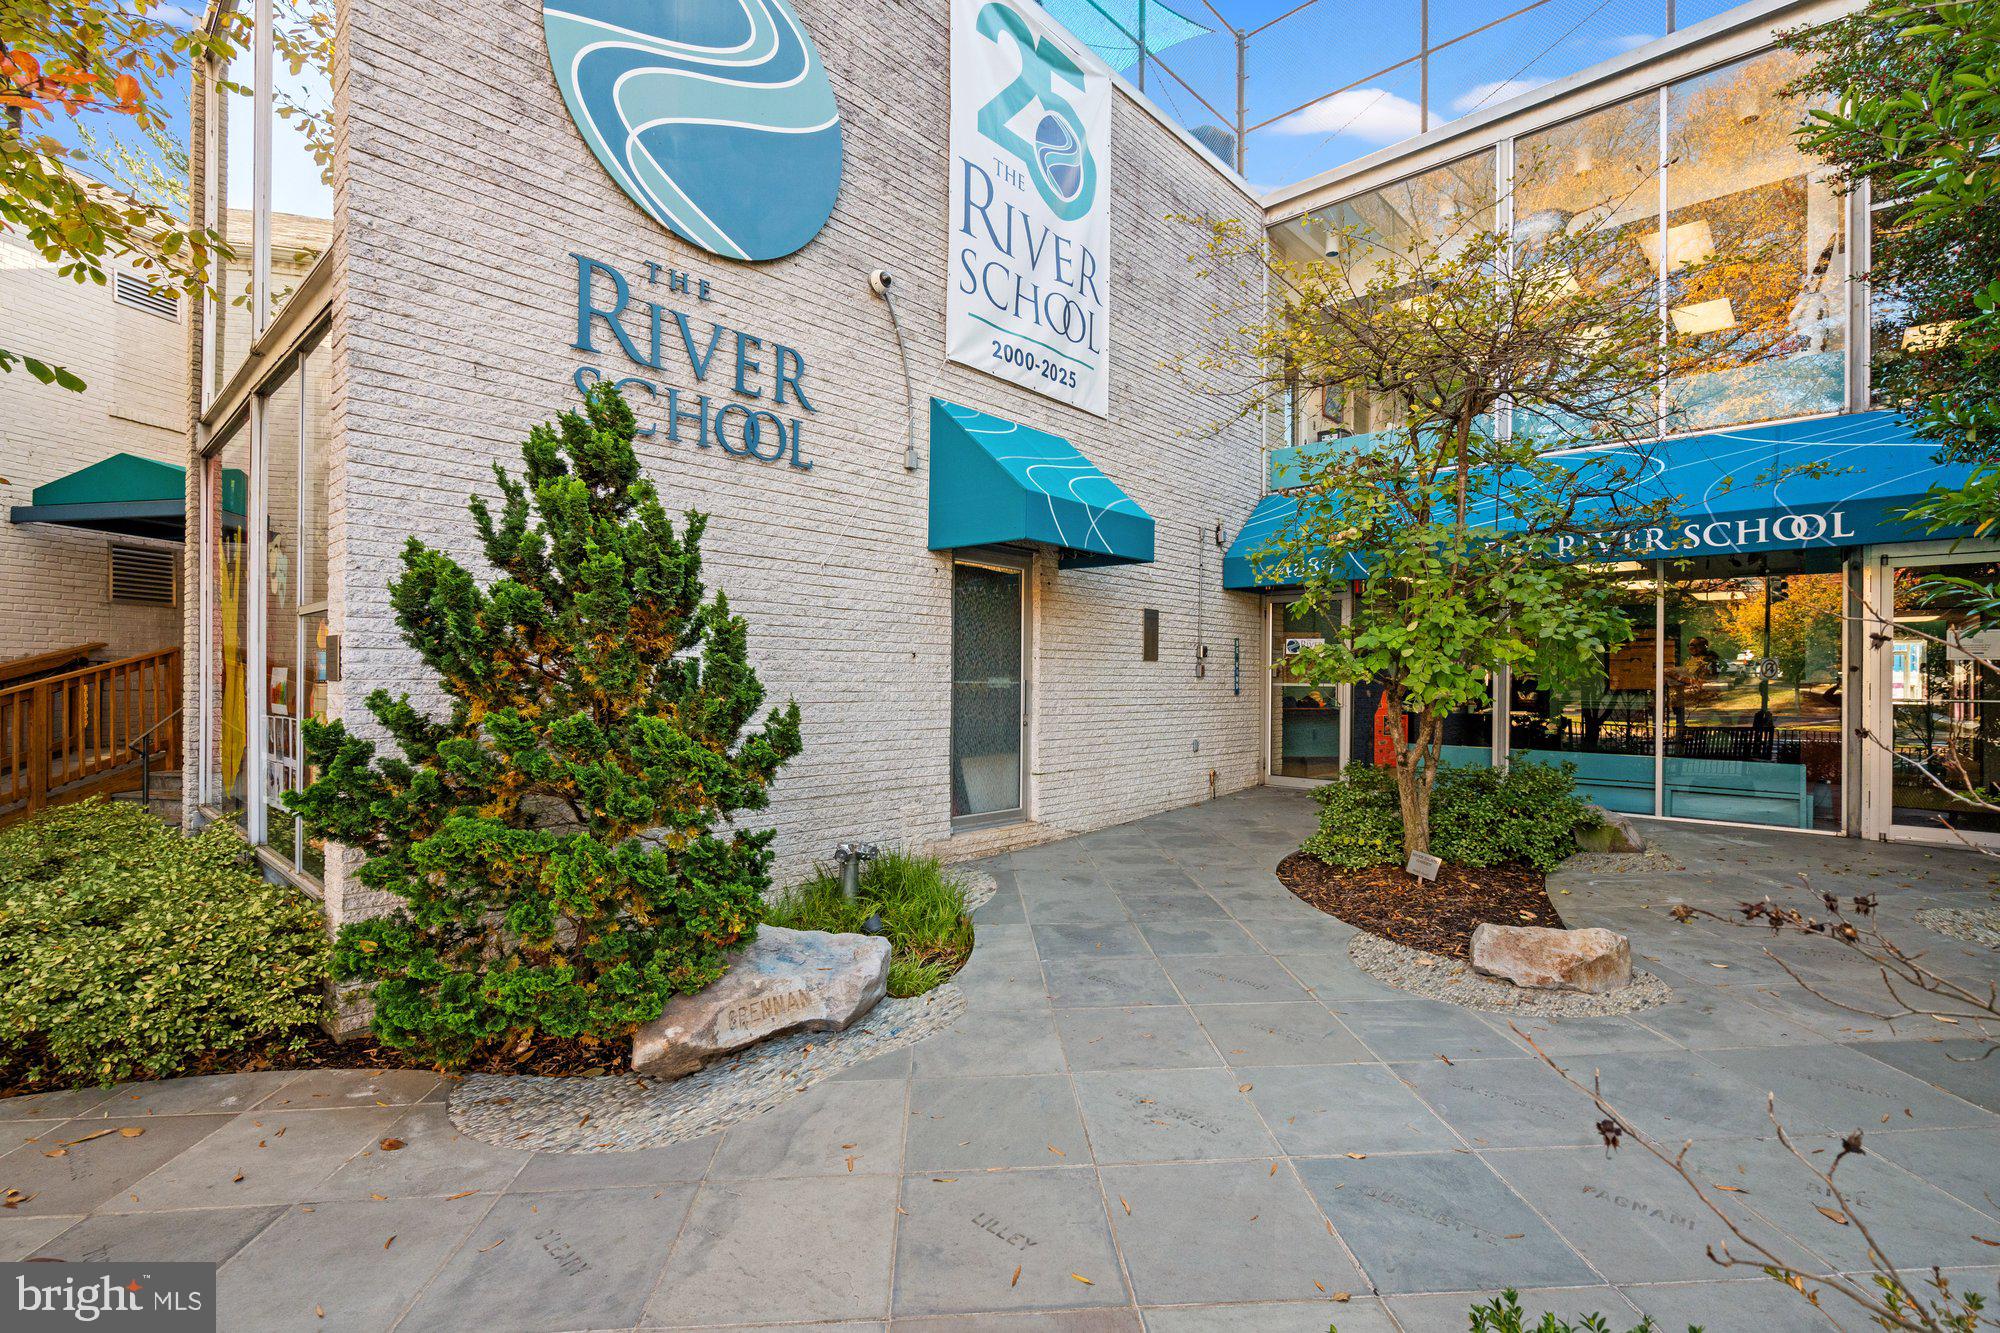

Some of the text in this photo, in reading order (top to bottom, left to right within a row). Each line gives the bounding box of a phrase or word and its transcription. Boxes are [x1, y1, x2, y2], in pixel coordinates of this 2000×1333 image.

[993, 157, 1025, 192] THE
[958, 155, 1103, 307] RIVER
[645, 259, 712, 301] THE
[960, 248, 1100, 355] SCHOOL
[568, 252, 818, 413] RIVER
[992, 340, 1077, 389] 2000-2025
[1683, 511, 1855, 549] SCHOOL
[729, 989, 812, 1030] BRENNAN
[971, 1212, 1038, 1250] LILLEY
